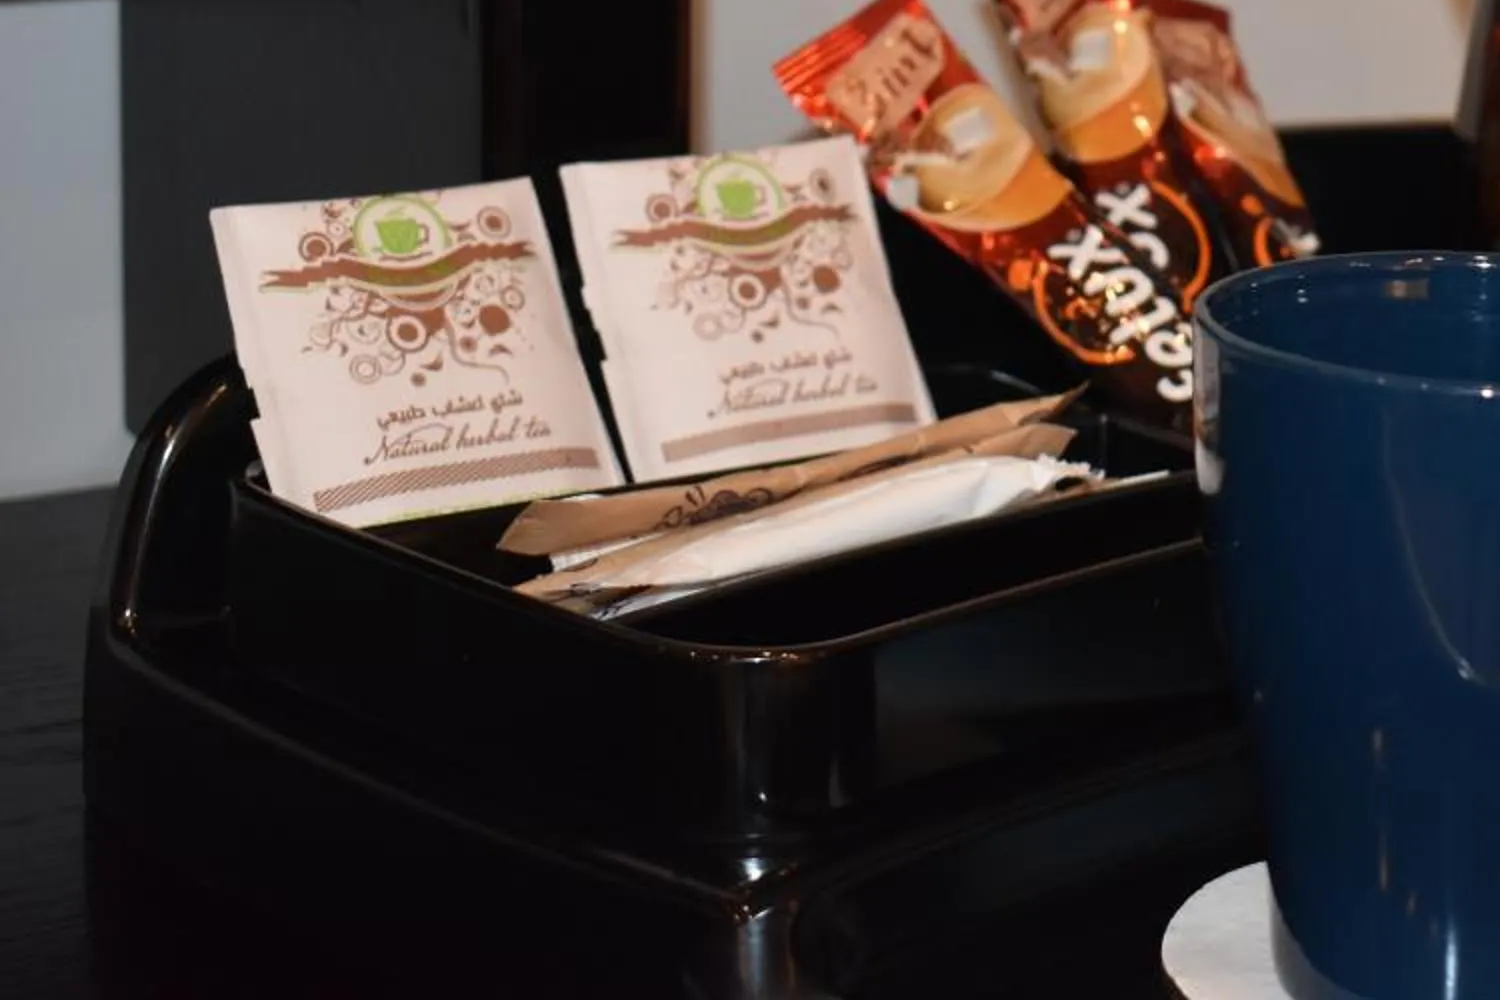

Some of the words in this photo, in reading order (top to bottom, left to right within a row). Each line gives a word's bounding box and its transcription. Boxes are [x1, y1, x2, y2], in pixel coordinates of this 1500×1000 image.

[363, 421, 455, 466] Natural
[455, 415, 520, 451] herbal
[525, 414, 552, 440] tea
